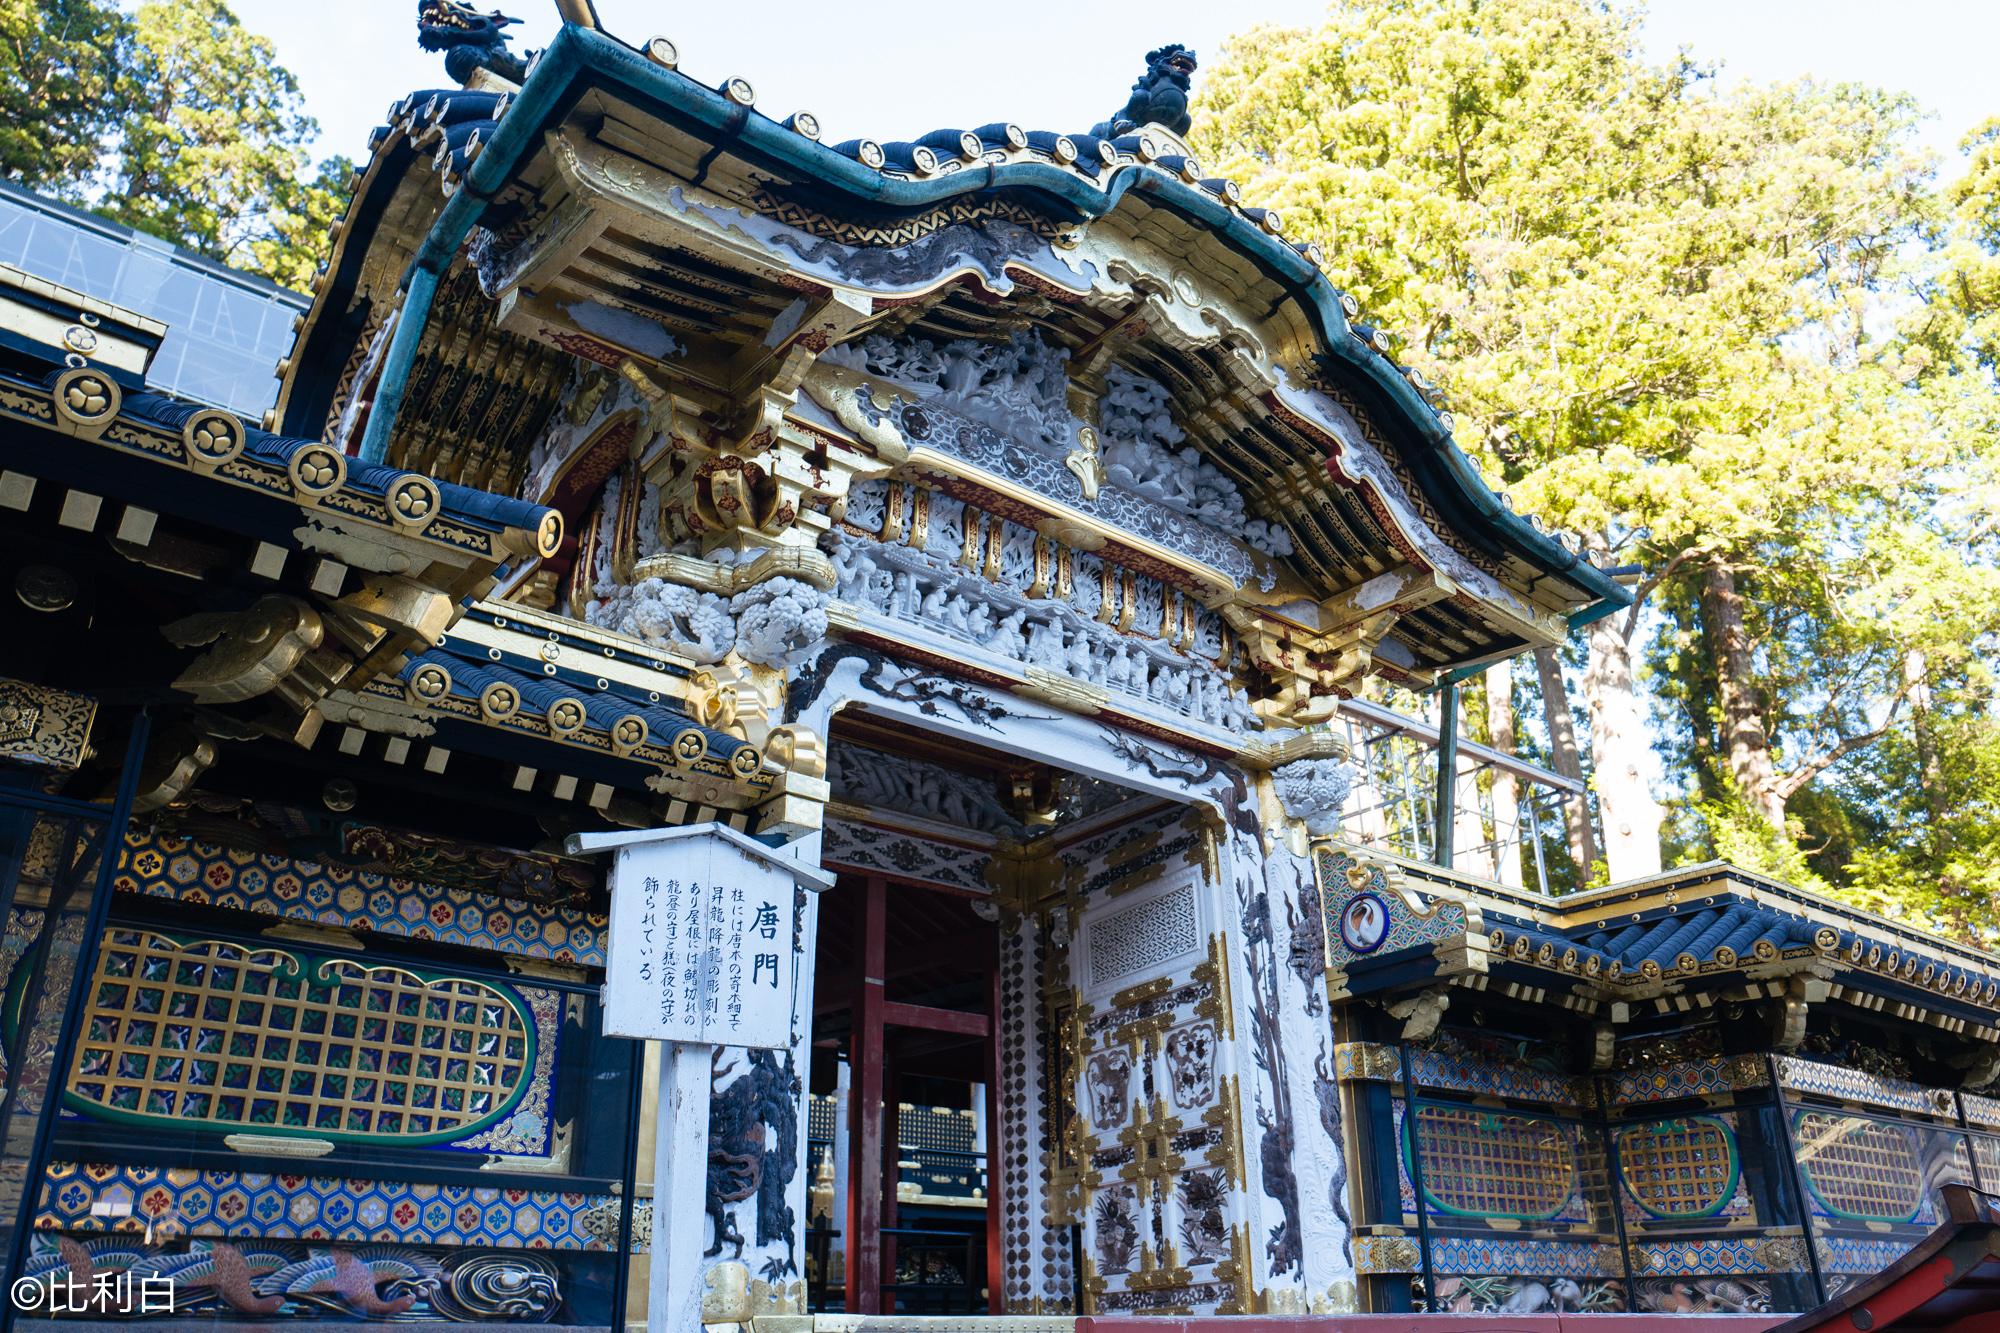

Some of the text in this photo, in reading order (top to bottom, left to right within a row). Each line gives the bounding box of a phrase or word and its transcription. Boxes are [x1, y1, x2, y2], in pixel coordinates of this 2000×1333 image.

[639, 876, 659, 981] 飾られている
[749, 901, 780, 990] 唐門
